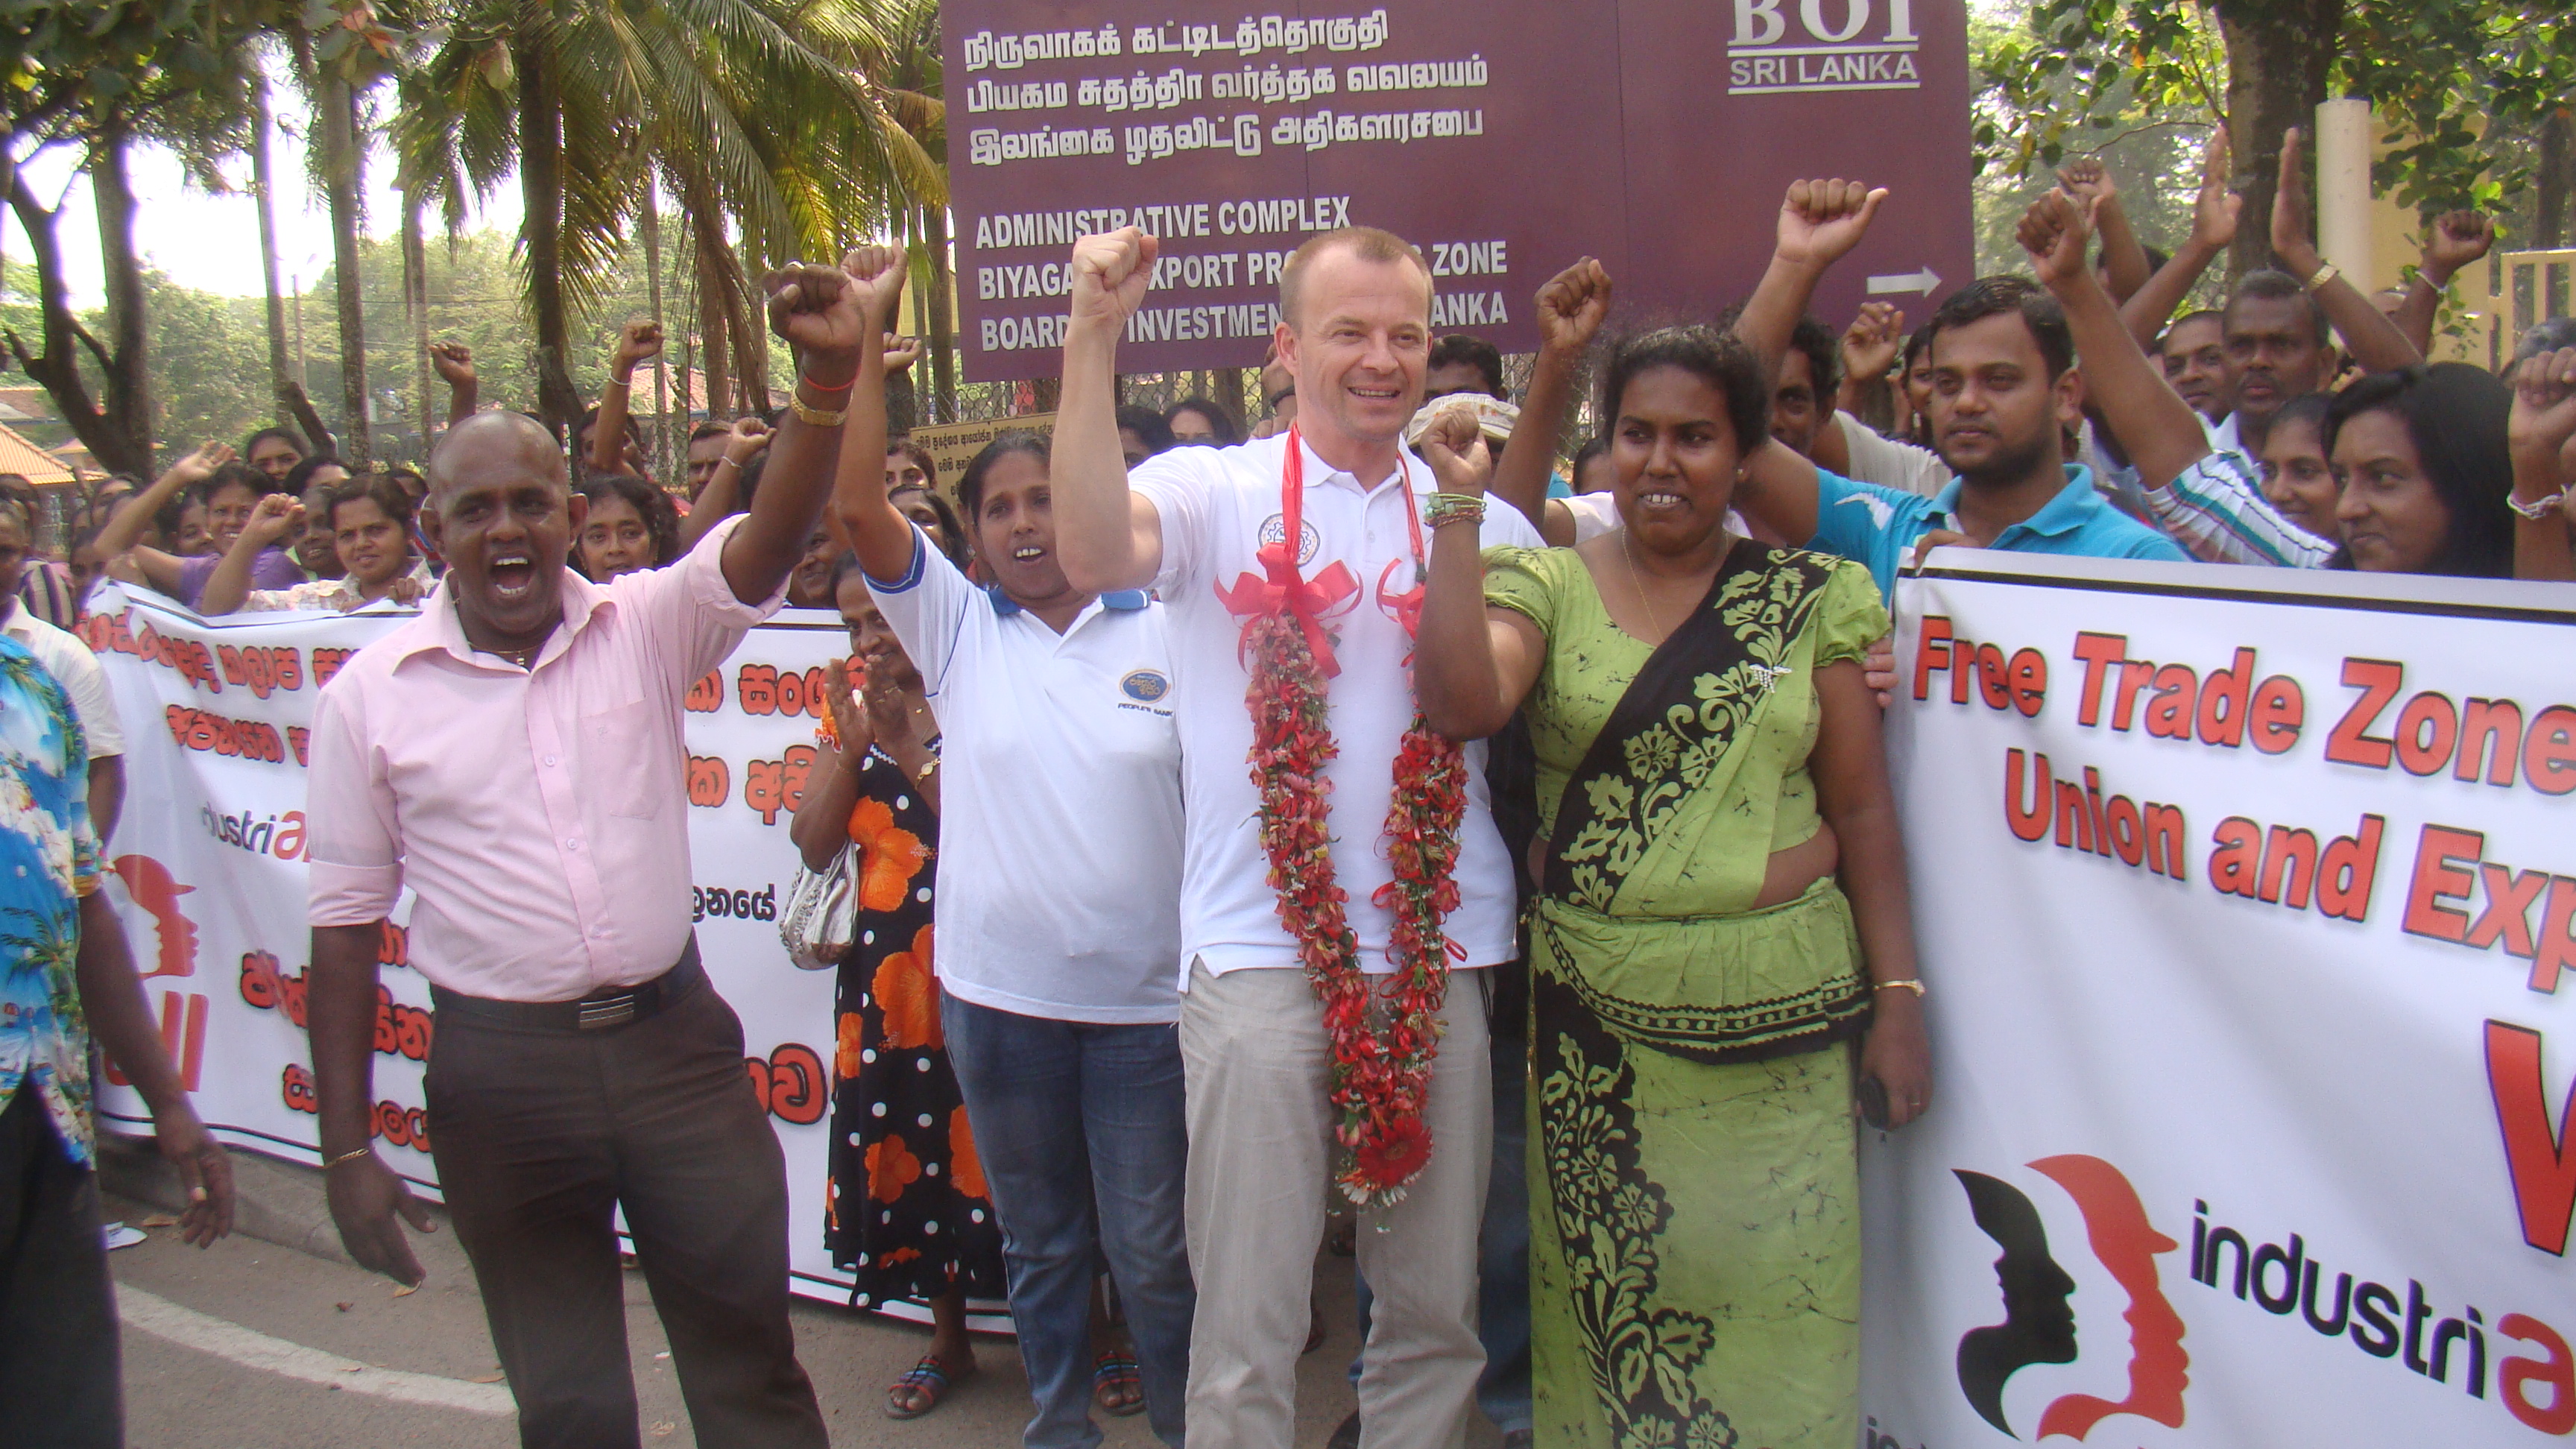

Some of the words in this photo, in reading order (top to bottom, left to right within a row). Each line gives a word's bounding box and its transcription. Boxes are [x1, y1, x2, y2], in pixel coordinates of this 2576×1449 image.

[1730, 58, 1787, 86] SRI
[1798, 54, 1918, 83] LANKA
[970, 124, 1114, 166] இலங்கை
[976, 203, 1210, 250] ADMINISTRATIVE
[1218, 195, 1351, 236] COMPLEX
[978, 262, 1074, 300] BIYAGA
[1148, 253, 1239, 291] XPORT
[1432, 240, 1508, 277] ZONE
[1126, 303, 1283, 343] INVESTMEN
[1429, 291, 1509, 328] ANKA
[1913, 614, 2048, 719] Free
[2073, 631, 2305, 756] Trade
[2324, 656, 2576, 796] Zone
[2005, 747, 2185, 882] Union
[2209, 812, 2385, 924] and
